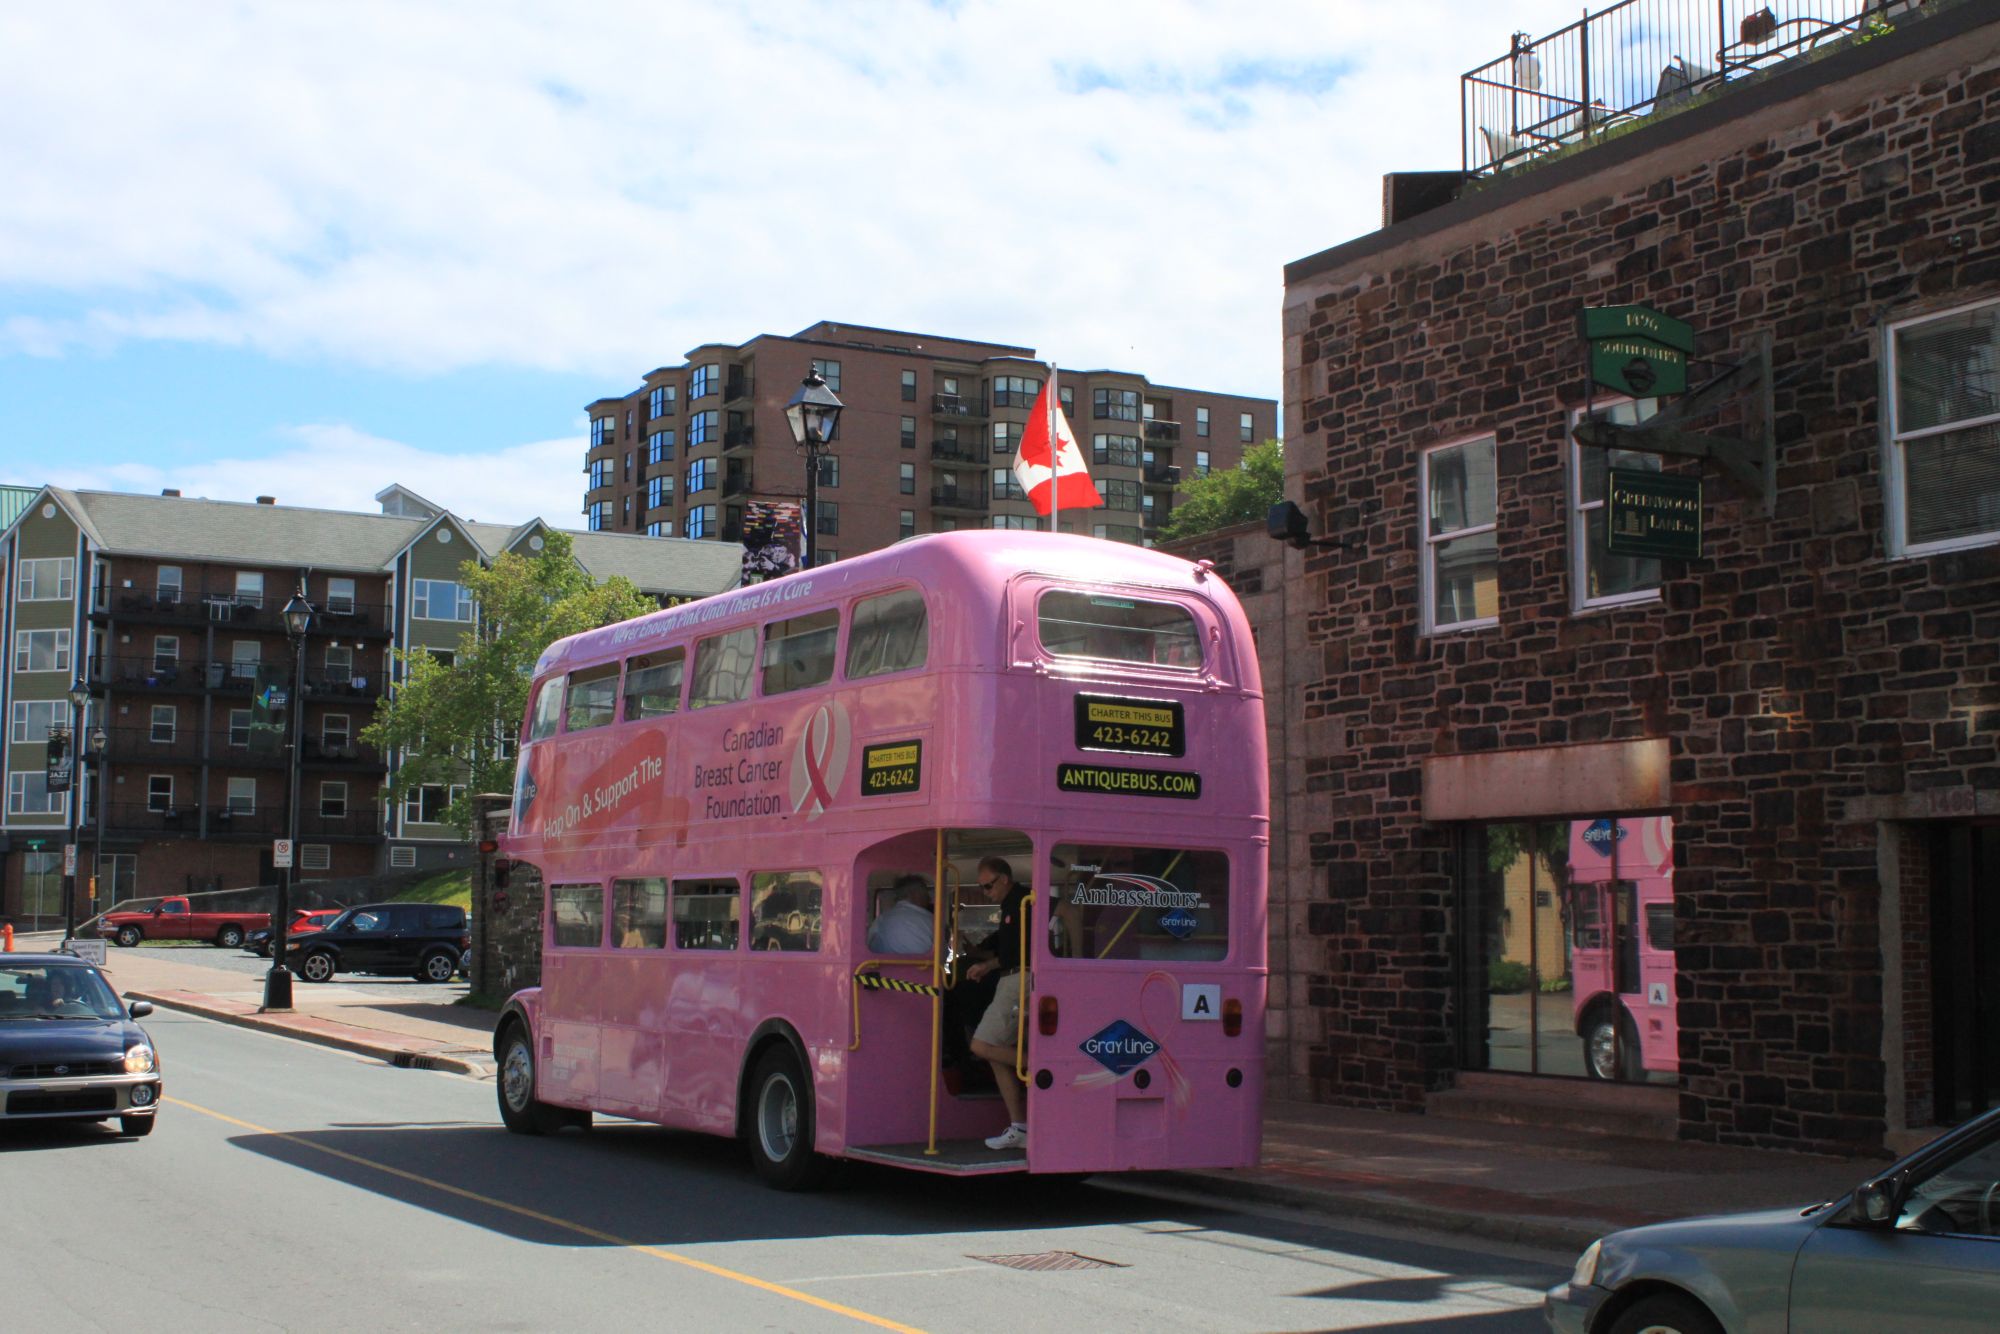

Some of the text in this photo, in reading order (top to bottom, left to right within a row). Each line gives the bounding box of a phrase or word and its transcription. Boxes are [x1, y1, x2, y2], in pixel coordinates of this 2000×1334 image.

[611, 580, 813, 645] Never Enough Pink Until There Is A Cure
[1090, 707, 1171, 723] CHARTER THIS BUS
[722, 721, 784, 752] Canadian
[1093, 726, 1170, 748] 423-6242
[694, 758, 783, 788] Breast Cancer
[869, 768, 914, 787] 423-6242
[1063, 769, 1196, 792] ANTIQUEBUS.COM
[543, 755, 662, 842] Hop On & Support The
[706, 789, 781, 819] Foundation
[1072, 882, 1199, 909] Ambassatours
[1161, 917, 1197, 928] Gray Line
[1193, 995, 1210, 1013] A
[1086, 1037, 1154, 1054] Gray Line
